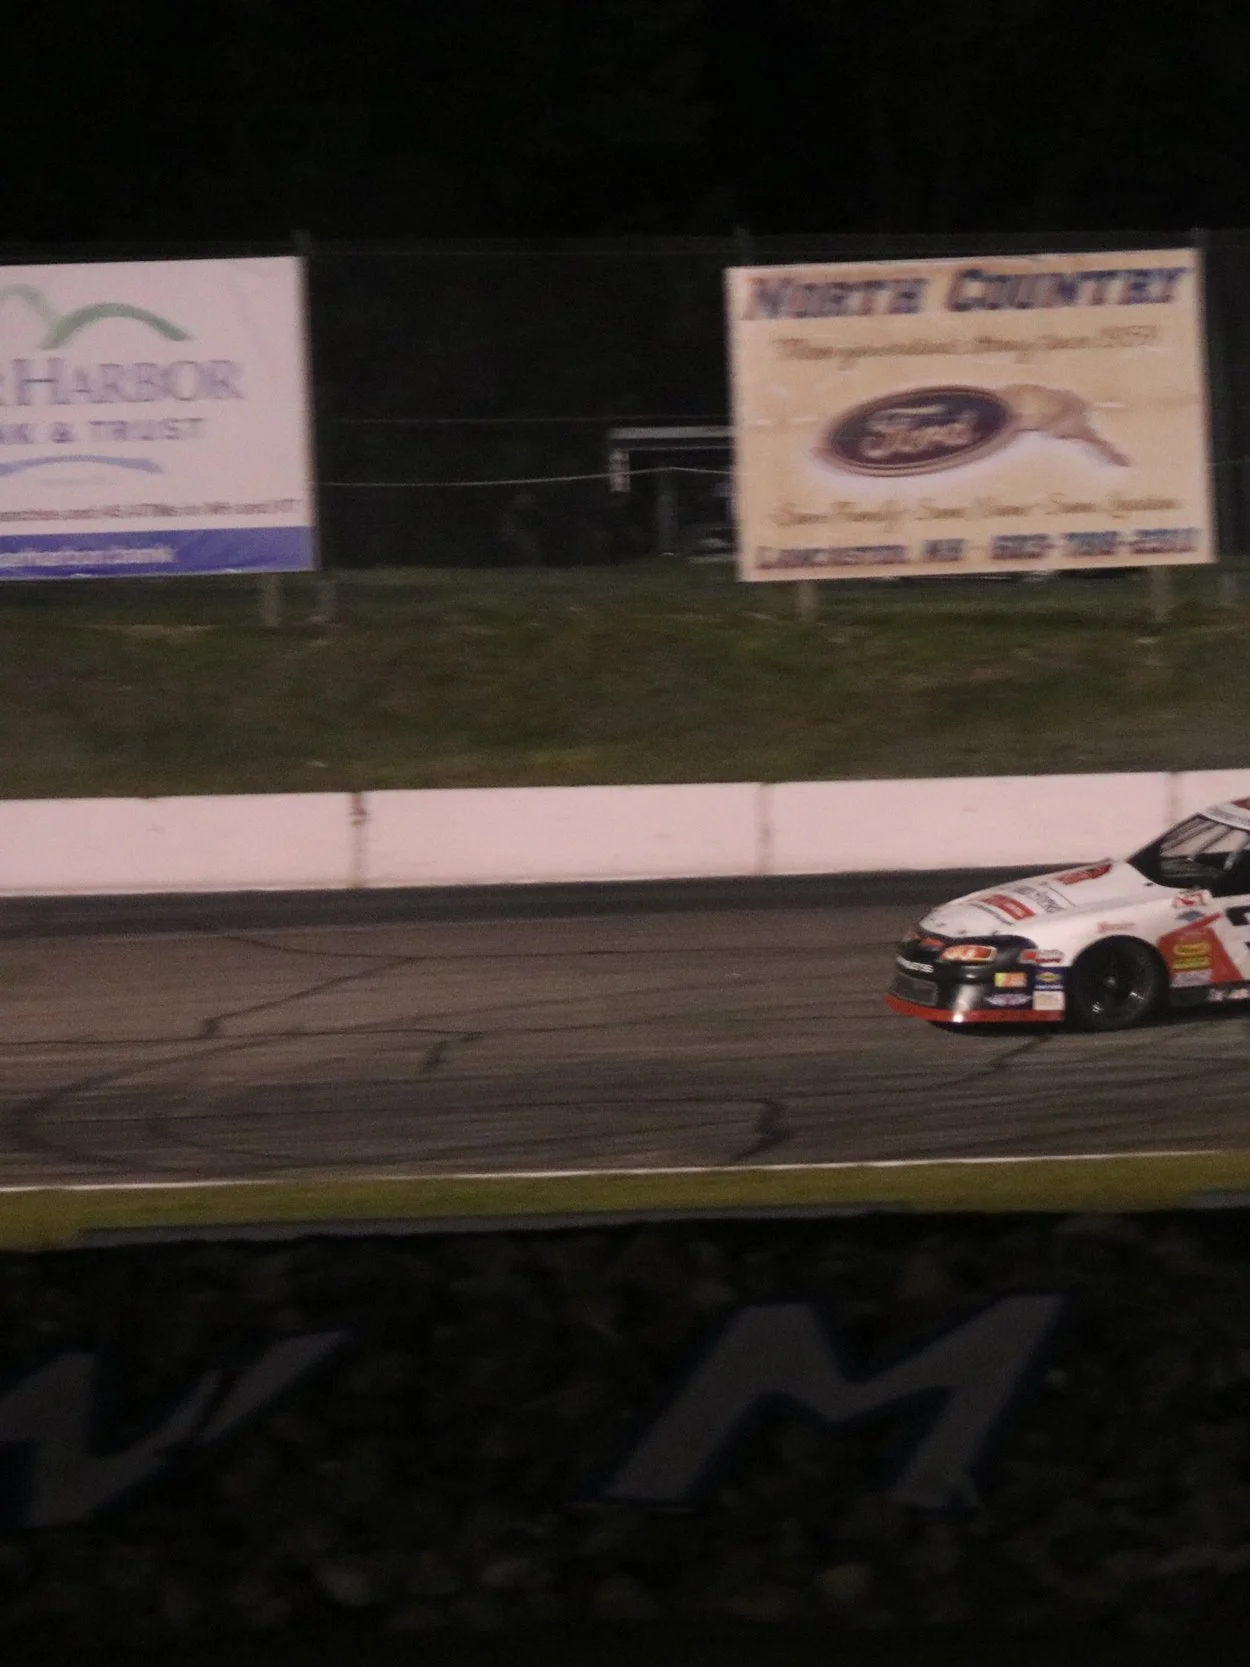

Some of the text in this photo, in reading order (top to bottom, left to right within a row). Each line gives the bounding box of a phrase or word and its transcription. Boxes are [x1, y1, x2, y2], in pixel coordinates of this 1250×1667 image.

[741, 267, 1190, 321] NORTH COUNTRY
[11, 357, 245, 406] HARBOR
[859, 403, 980, 460] Ford
